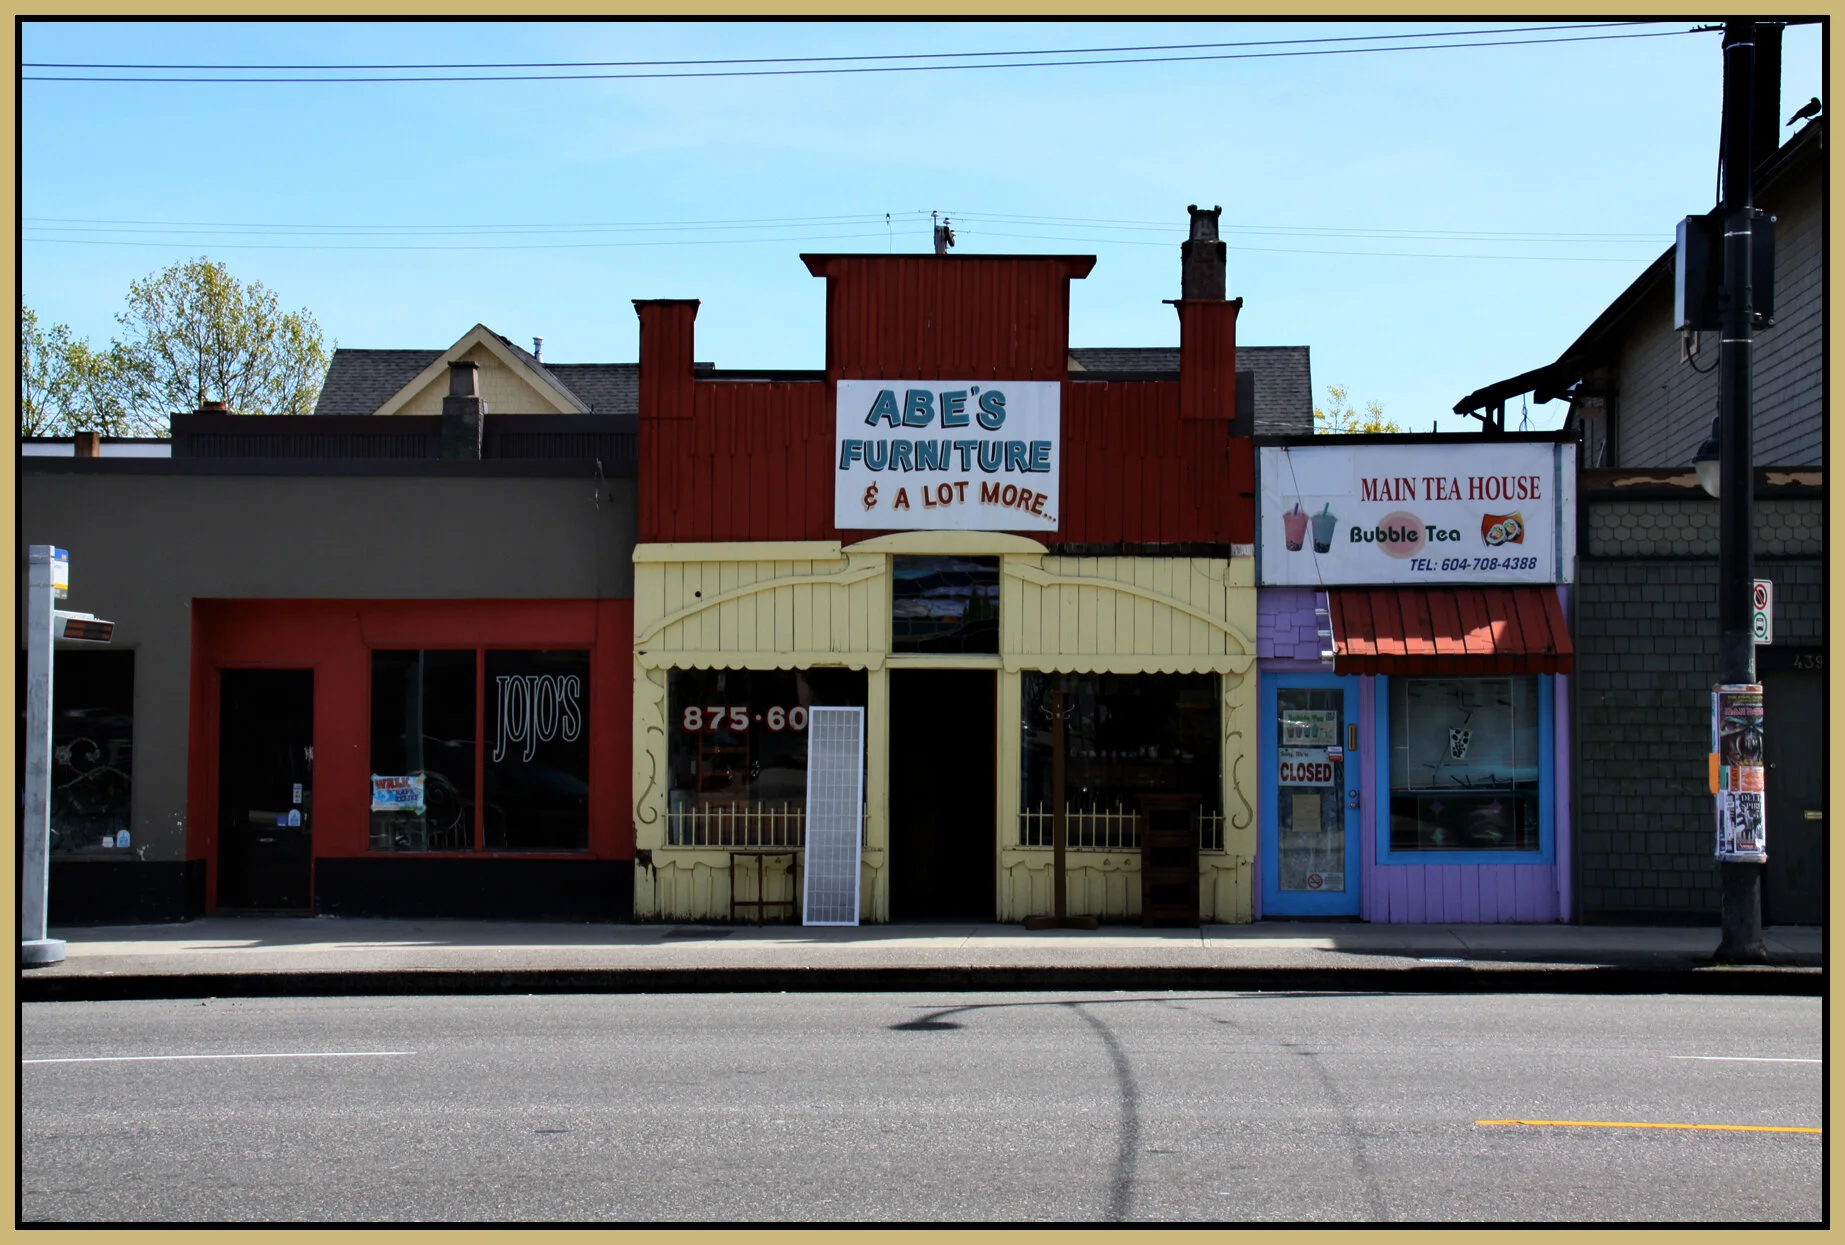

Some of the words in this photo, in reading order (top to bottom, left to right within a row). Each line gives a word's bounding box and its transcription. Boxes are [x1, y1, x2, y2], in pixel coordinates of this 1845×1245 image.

[865, 385, 1006, 431] ABE'S
[839, 439, 1052, 473] FURNITURE
[863, 481, 879, 511] &
[893, 487, 910, 510] A
[922, 481, 969, 509] LOT
[1361, 477, 1416, 502] MAIN
[1422, 476, 1462, 501] TEA
[1468, 475, 1542, 500] HOUSE
[1350, 526, 1419, 543] Bubble
[1425, 525, 1461, 542] Tea
[1410, 559, 1438, 572] TEL:
[1441, 557, 1537, 571] 604-708-4388
[493, 674, 582, 763] JOJO'S
[1280, 762, 1332, 782] CLOSED
